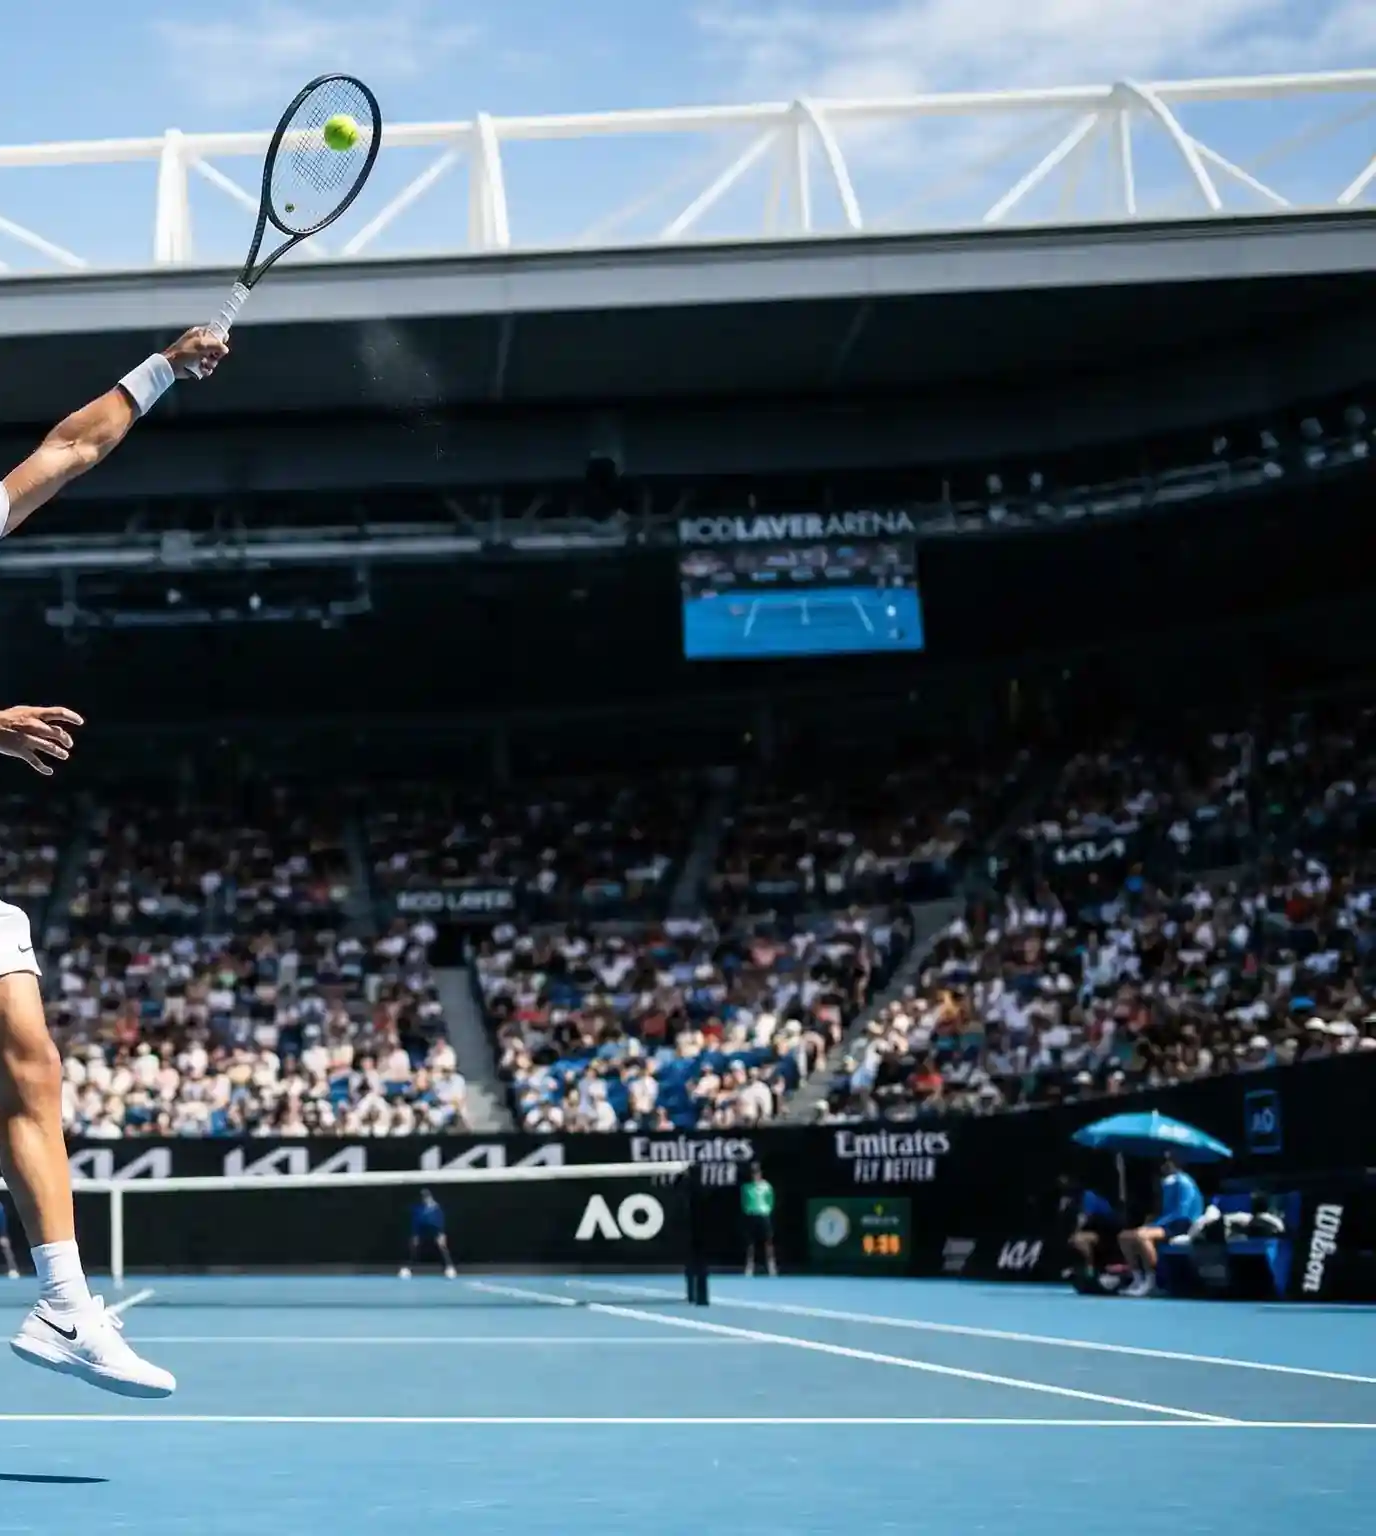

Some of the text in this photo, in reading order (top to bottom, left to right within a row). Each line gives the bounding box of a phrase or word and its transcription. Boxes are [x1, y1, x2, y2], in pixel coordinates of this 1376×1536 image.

[631, 1135, 753, 1162] Emirates
[835, 1129, 950, 1158] Emirates
[575, 1193, 664, 1240] AO
[1303, 1203, 1344, 1293] Wilson
